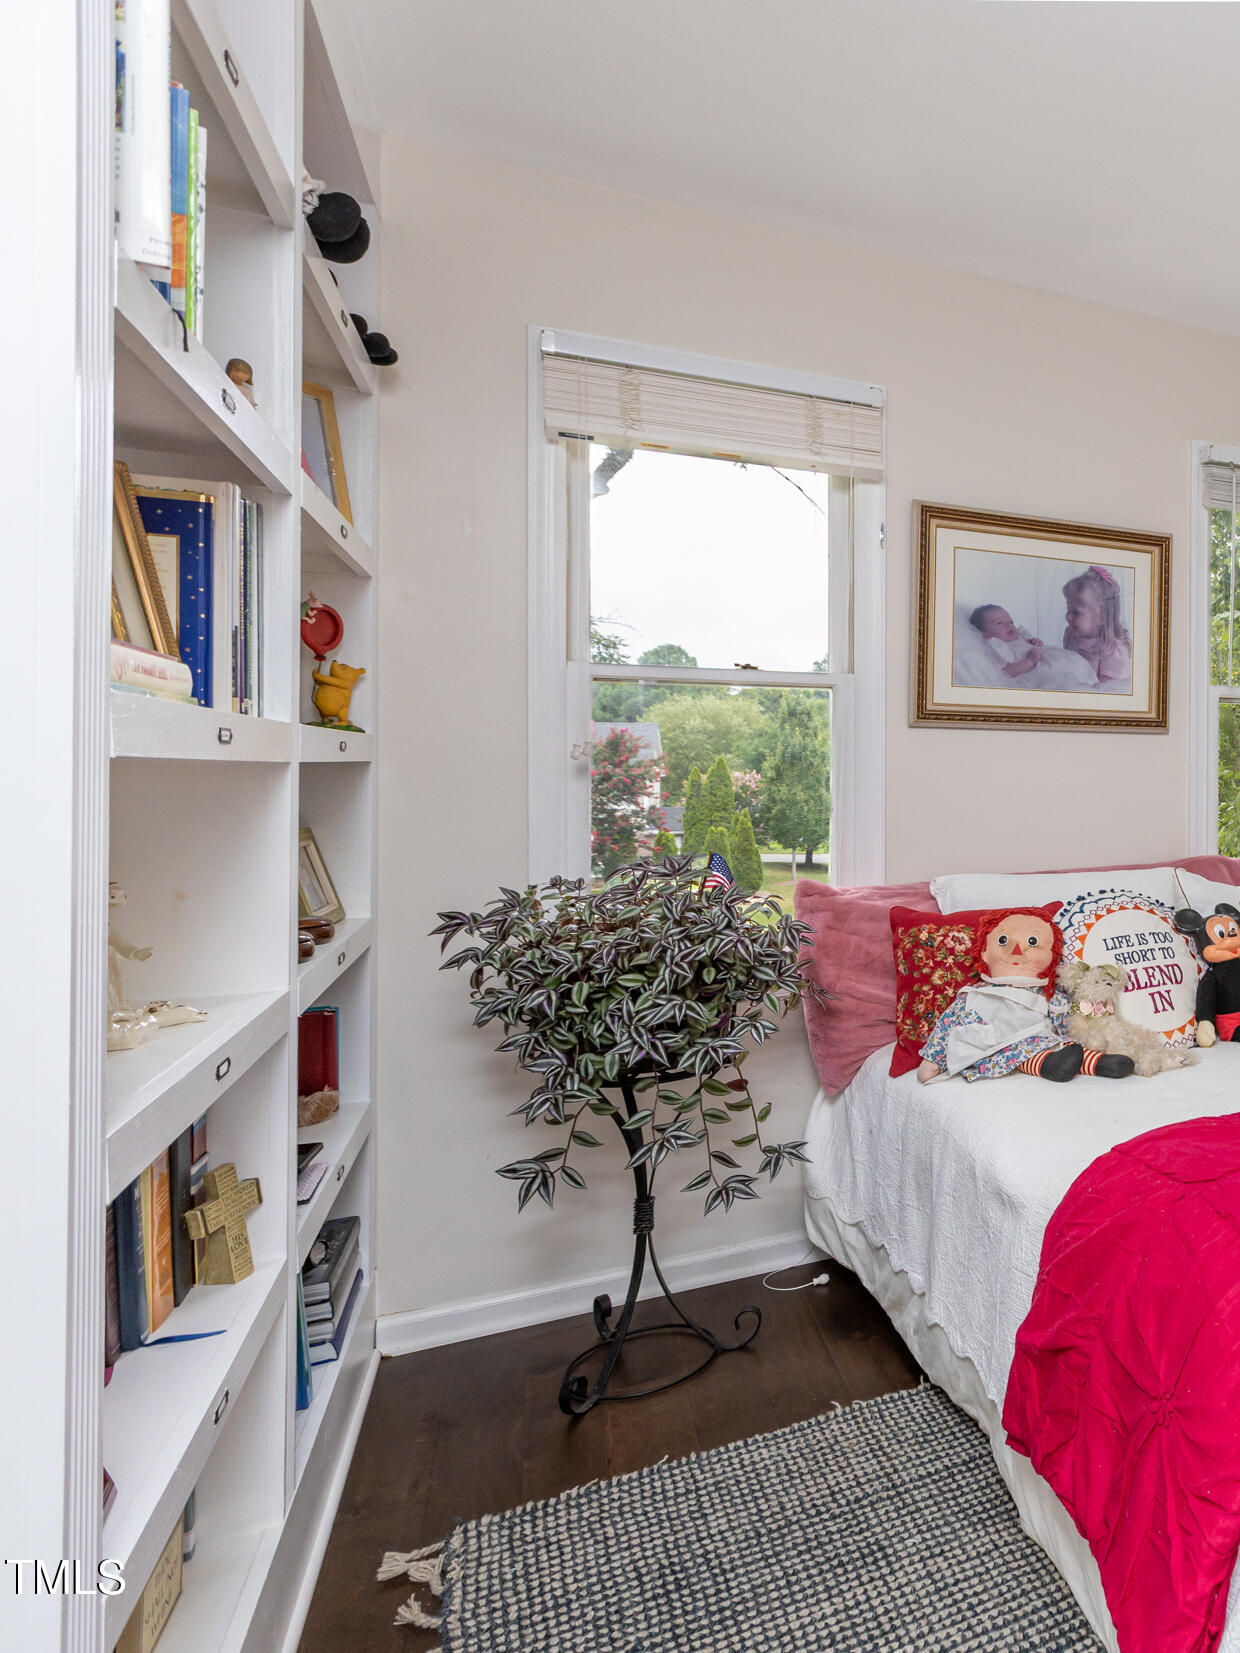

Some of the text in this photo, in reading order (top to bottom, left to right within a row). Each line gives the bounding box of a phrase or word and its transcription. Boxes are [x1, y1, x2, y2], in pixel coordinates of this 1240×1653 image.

[1102, 931, 1174, 952] LIFE IS TOO
[1114, 947, 1175, 965] SHORT TO
[1123, 963, 1184, 993] BLEND
[1148, 989, 1175, 1015] IN
[205, 1200, 222, 1214] INTO
[230, 1237, 249, 1253] LOVE
[231, 1233, 245, 1243] HIS
